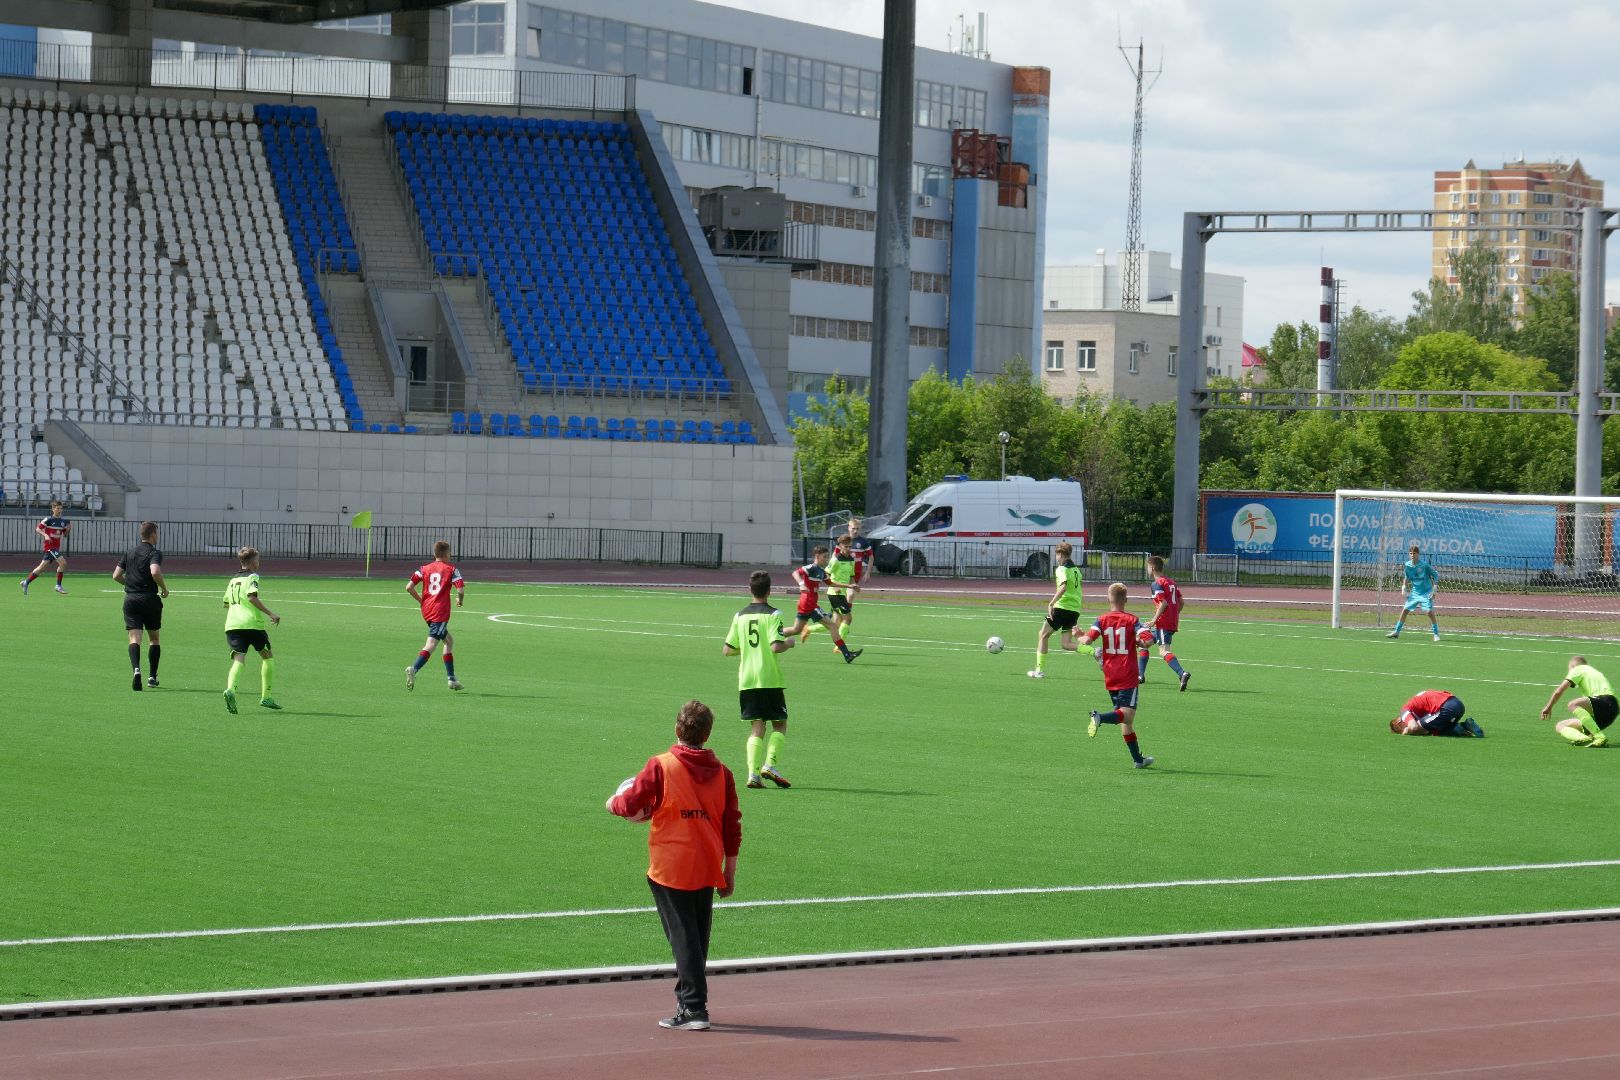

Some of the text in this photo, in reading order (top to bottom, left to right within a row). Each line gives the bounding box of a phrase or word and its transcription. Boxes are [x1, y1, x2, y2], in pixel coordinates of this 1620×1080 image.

[230, 581, 242, 605] 17
[428, 572, 441, 596] 8
[1168, 584, 1176, 605] 7
[748, 619, 760, 648] 5
[1103, 626, 1129, 655] 11
